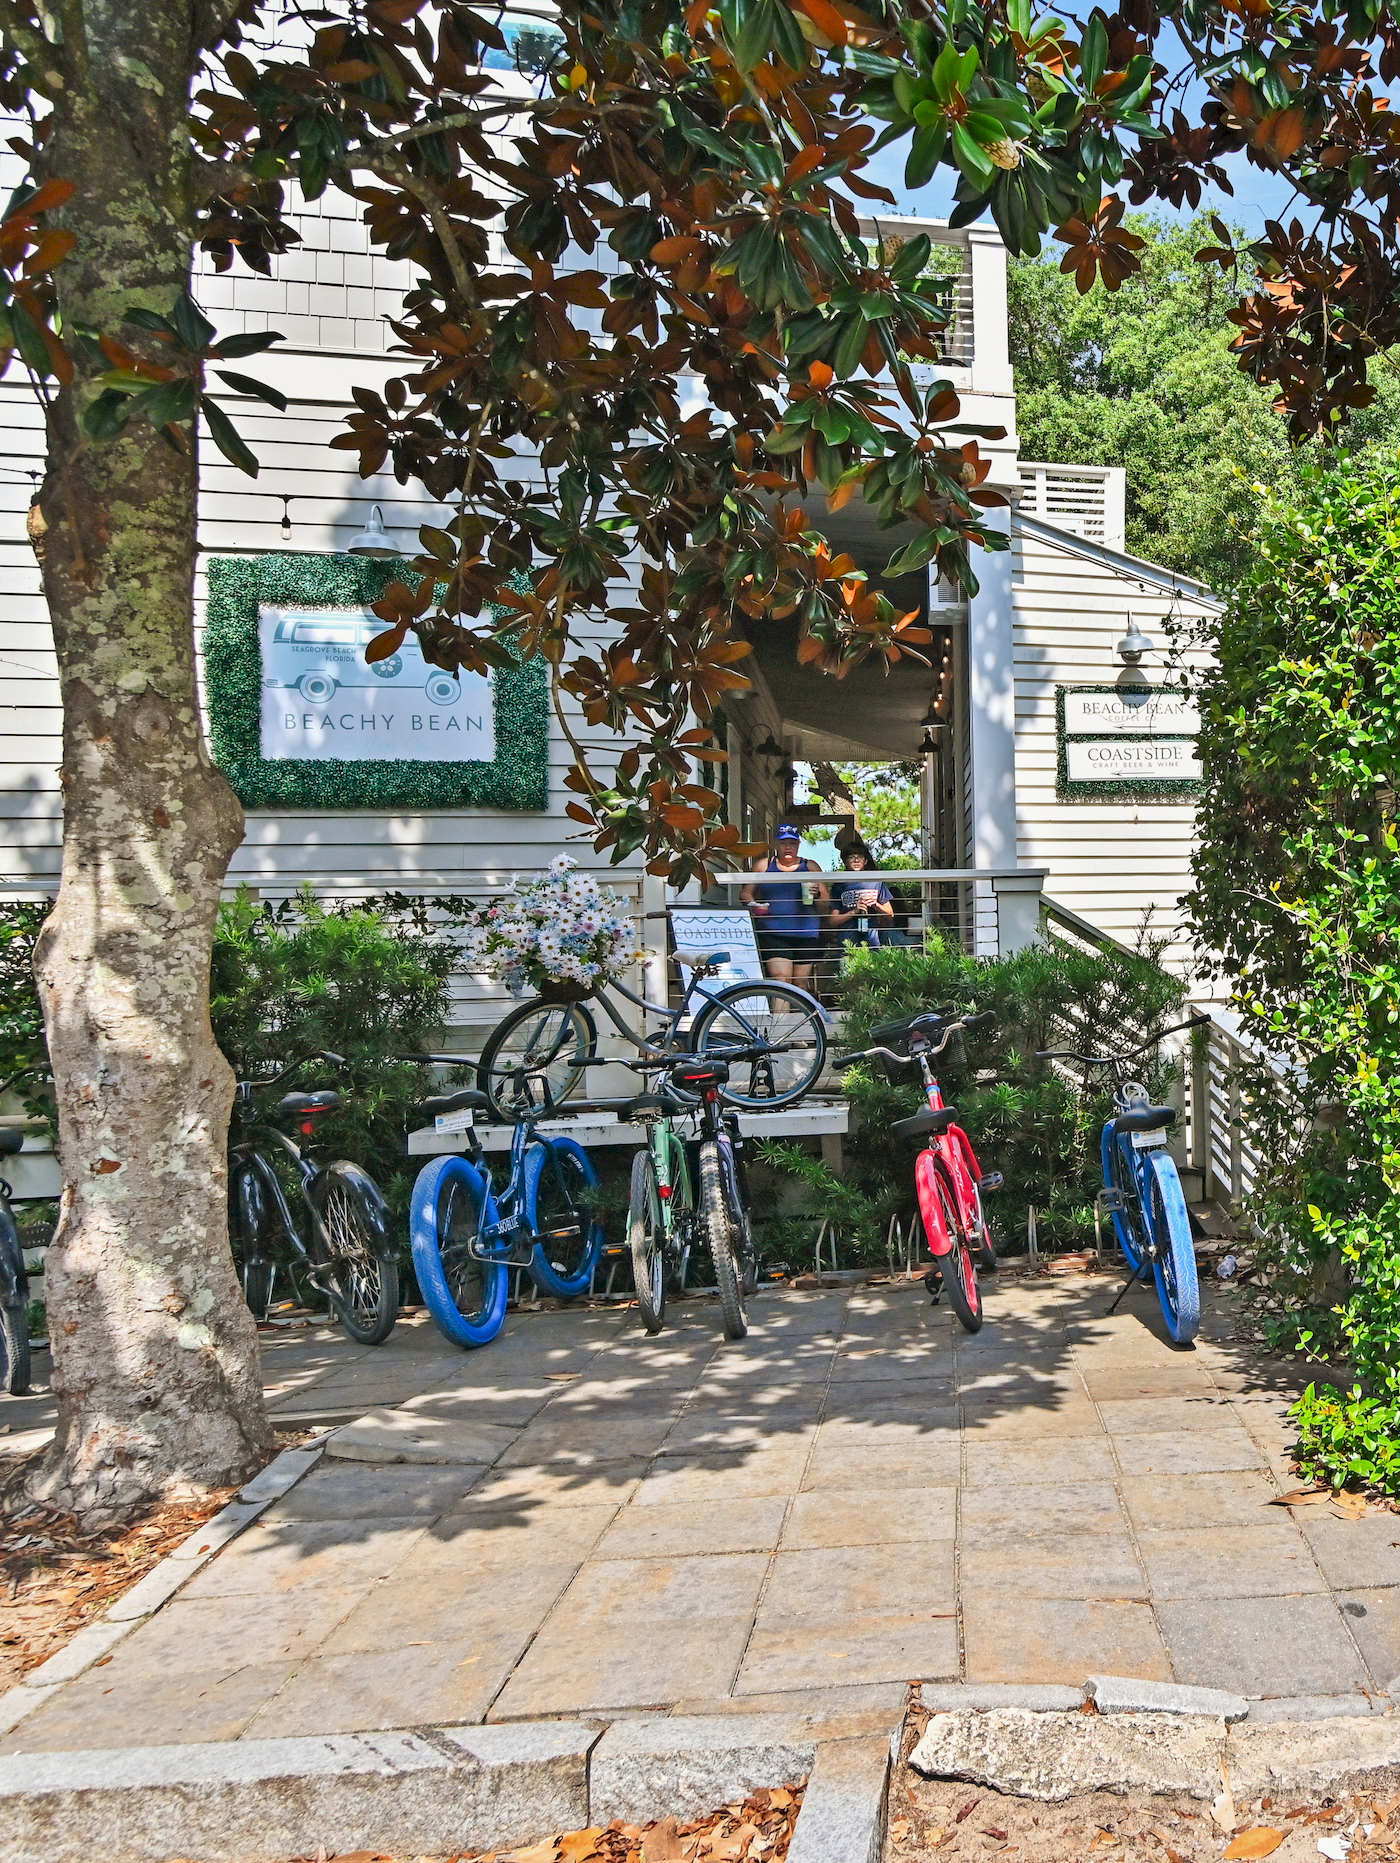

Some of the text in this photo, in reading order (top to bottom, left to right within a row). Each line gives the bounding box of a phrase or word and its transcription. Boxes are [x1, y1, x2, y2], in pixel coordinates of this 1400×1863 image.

[291, 646, 331, 654] SEAGROVE
[1083, 702, 1185, 715] BEACHY BEAN
[285, 713, 483, 732] BEACHY BEAN
[1087, 746, 1183, 761] COASTSIDE
[674, 927, 753, 940] COASTSIDE
